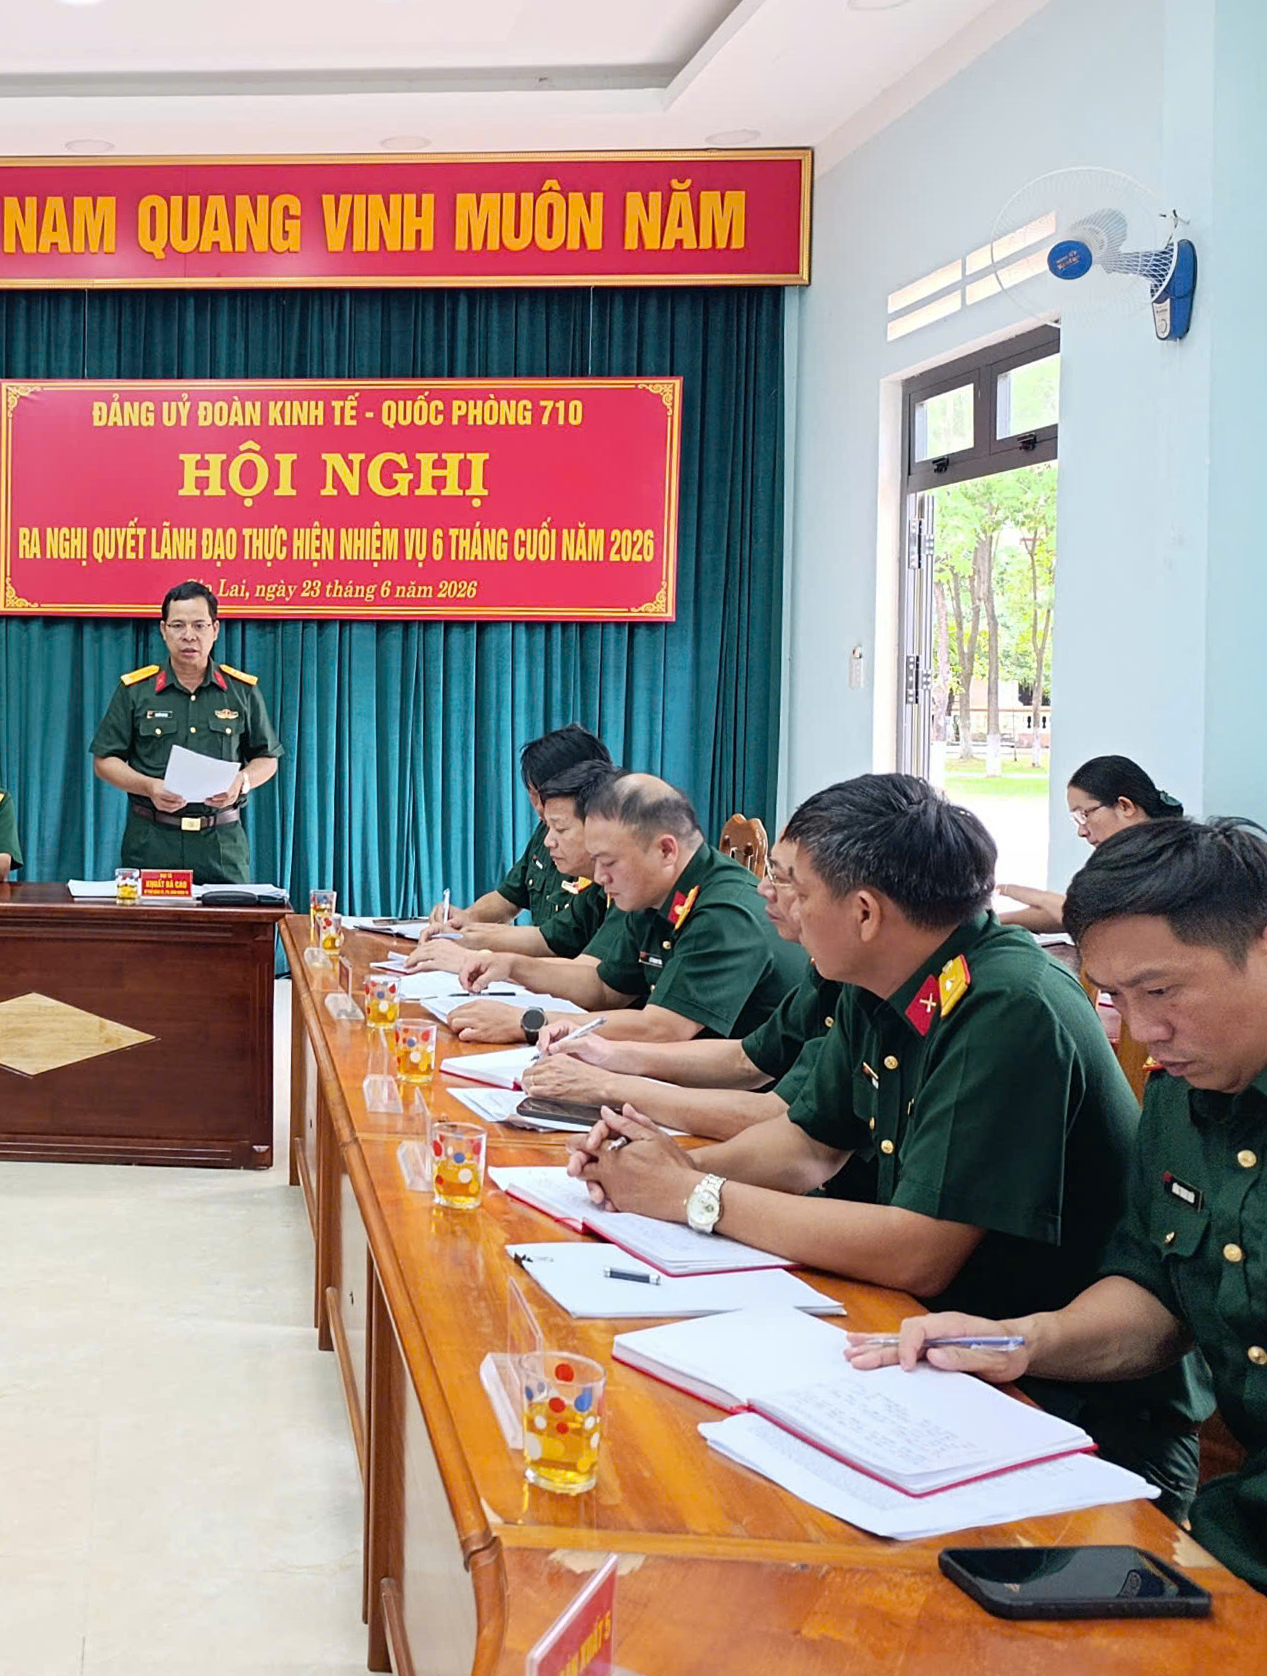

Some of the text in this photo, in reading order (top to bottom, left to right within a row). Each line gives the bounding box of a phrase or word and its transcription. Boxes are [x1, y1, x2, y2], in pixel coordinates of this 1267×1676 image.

[3, 196, 117, 254] NAM
[137, 194, 300, 260] QUANG
[321, 193, 435, 253] VINH
[455, 179, 604, 251] MUÔN
[624, 178, 746, 250] NĂM
[92, 393, 155, 427] ĐẢNG
[162, 392, 191, 427] UỶ
[197, 396, 261, 427] ĐOÀN
[268, 400, 325, 427] KINH
[331, 393, 360, 426] TẾ
[381, 391, 444, 428] QUỐC
[451, 394, 533, 426] PHÒNG
[539, 400, 583, 426] 710
[178, 439, 490, 508] HỘI NGHỊ
[18, 517, 655, 568] RA NGHỊ QUYẾT LÃNH ĐẠO THỰC HIỆN NHIỆM VỤ 6 THÁNG CUỐI NĂM 2026
[217, 578, 250, 600] Lai,
[254, 579, 297, 602] ngày
[300, 579, 322, 598] 23
[325, 579, 376, 602] tháng
[380, 580, 392, 598] 6
[395, 581, 433, 598] năm
[437, 580, 478, 599] 2026
